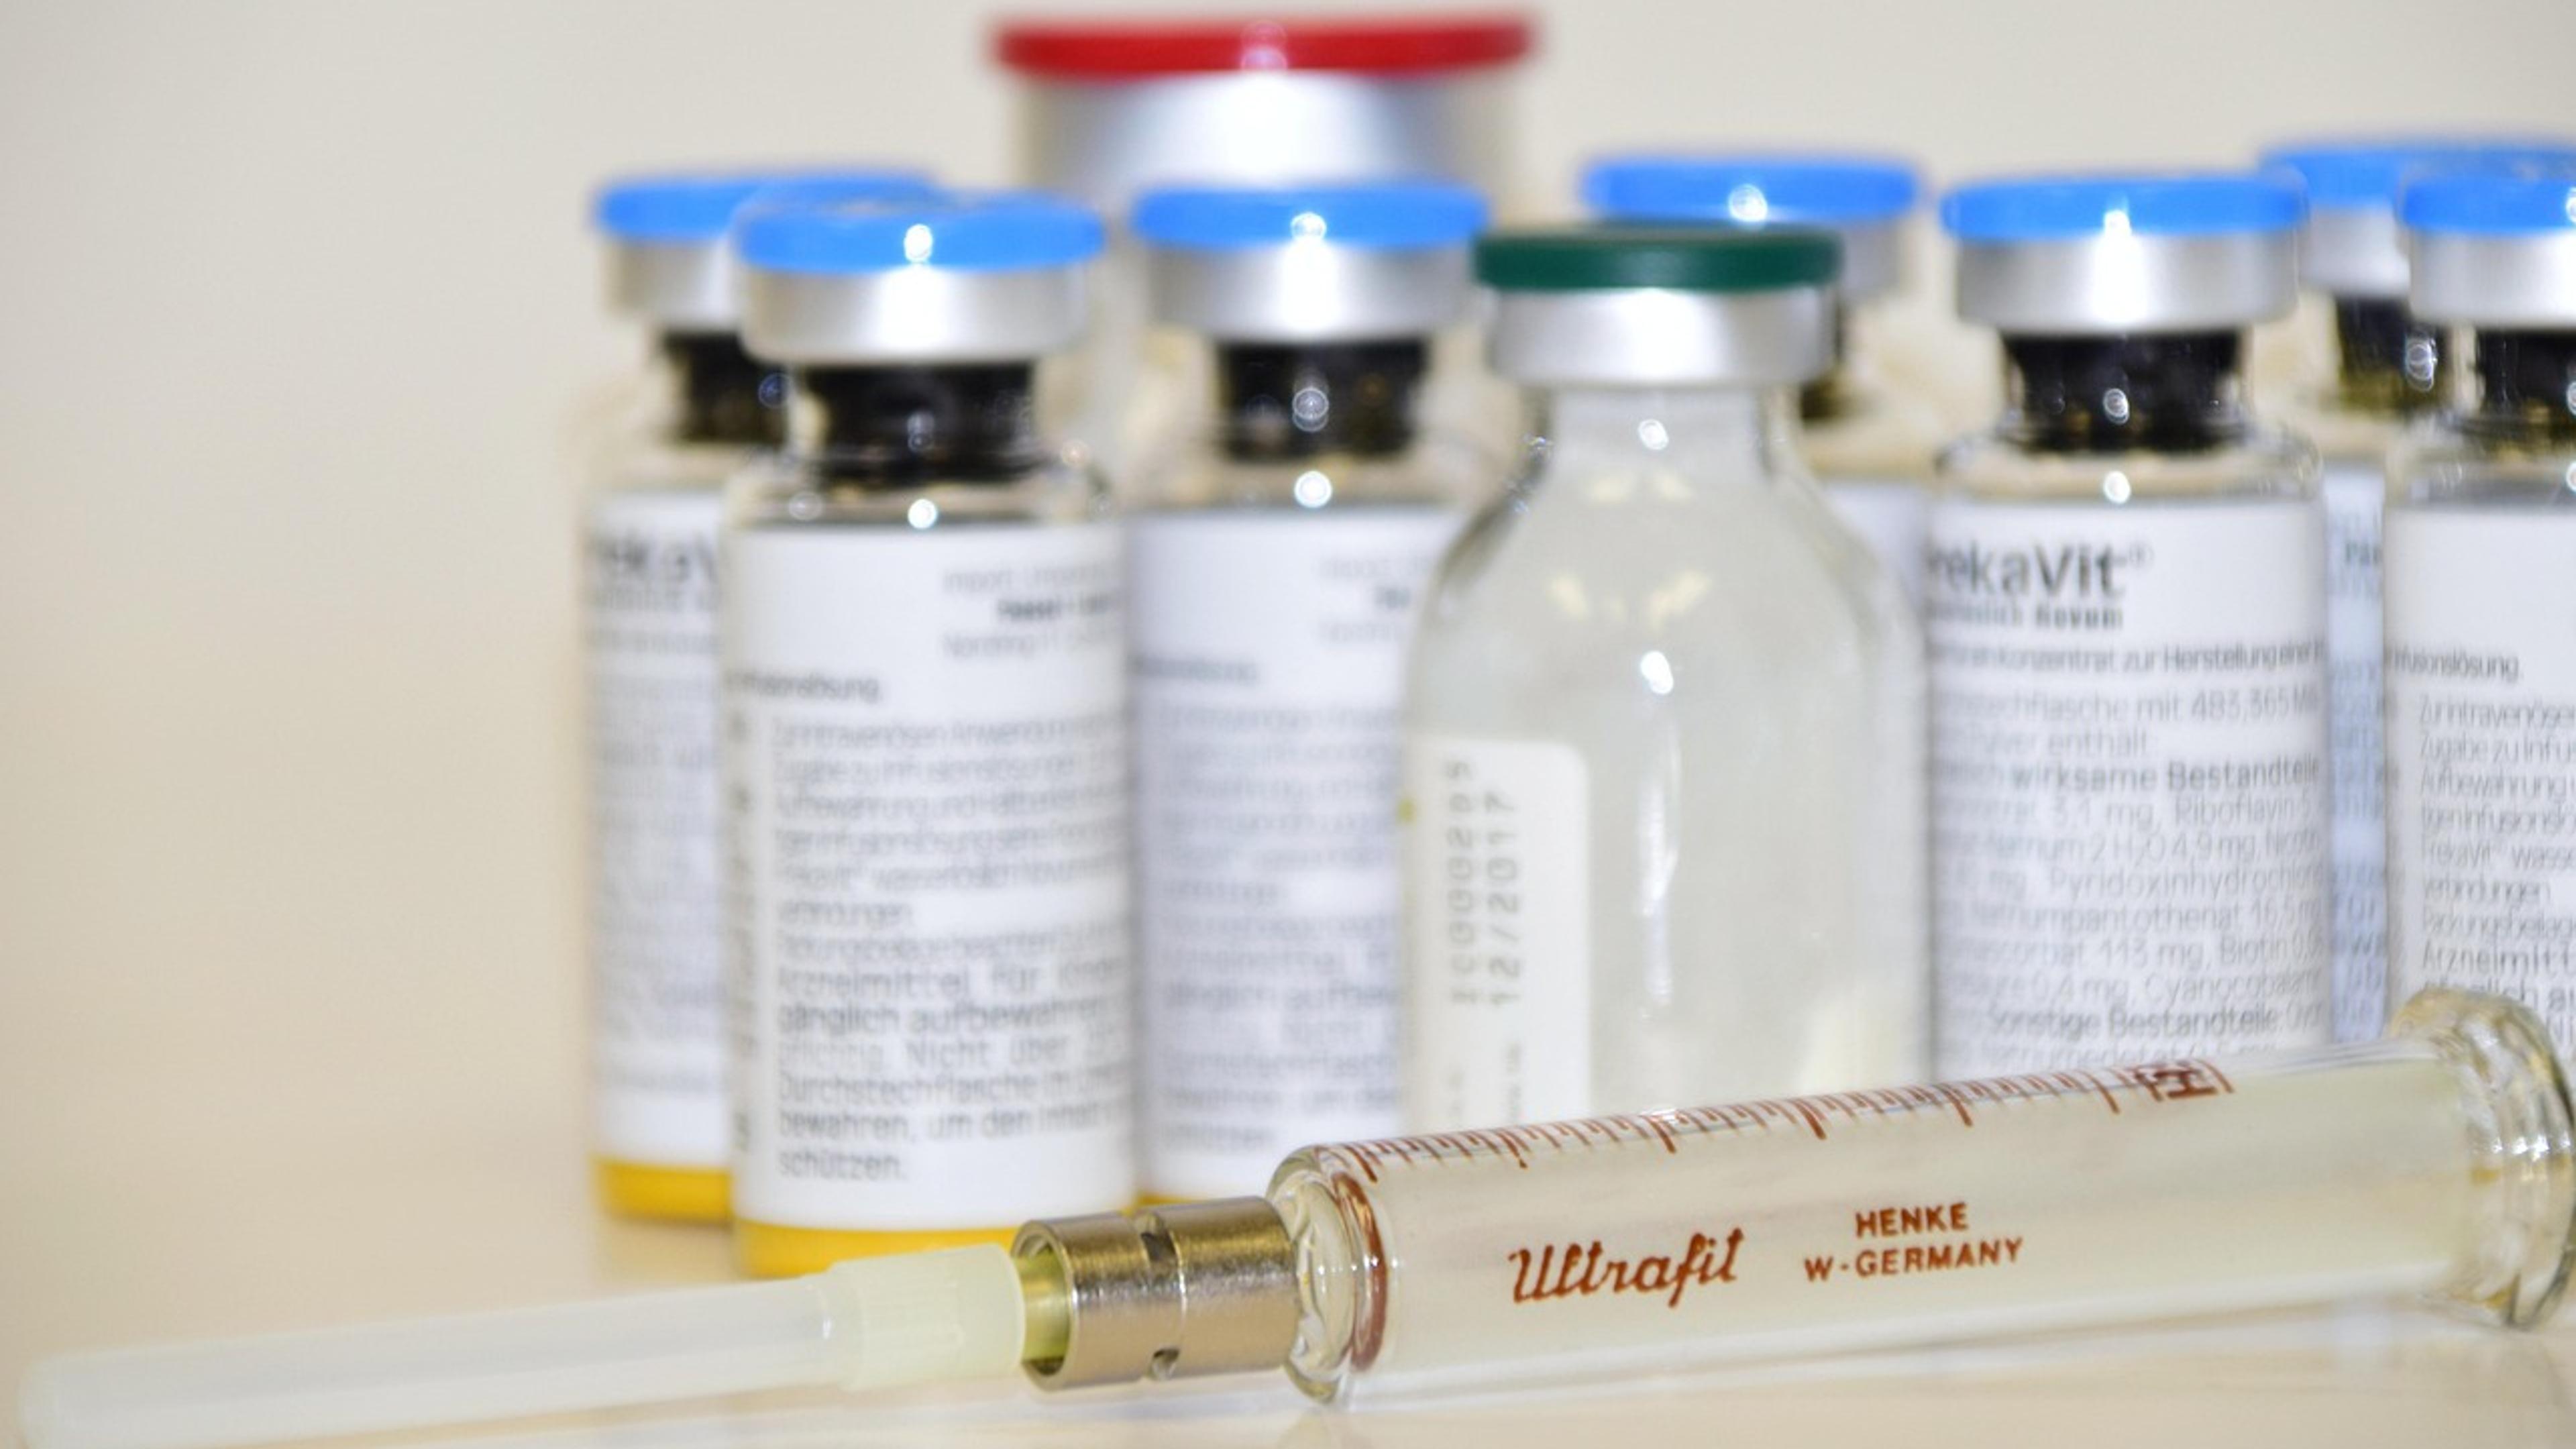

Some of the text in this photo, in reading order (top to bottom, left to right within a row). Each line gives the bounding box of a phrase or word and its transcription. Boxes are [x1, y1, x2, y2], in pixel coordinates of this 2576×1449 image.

[2012, 761, 2158, 792] wirksame
[1485, 789, 1520, 1006] 12/2017
[1855, 1201, 1969, 1239] HENKE
[1508, 1226, 1745, 1309] Ultrafit
